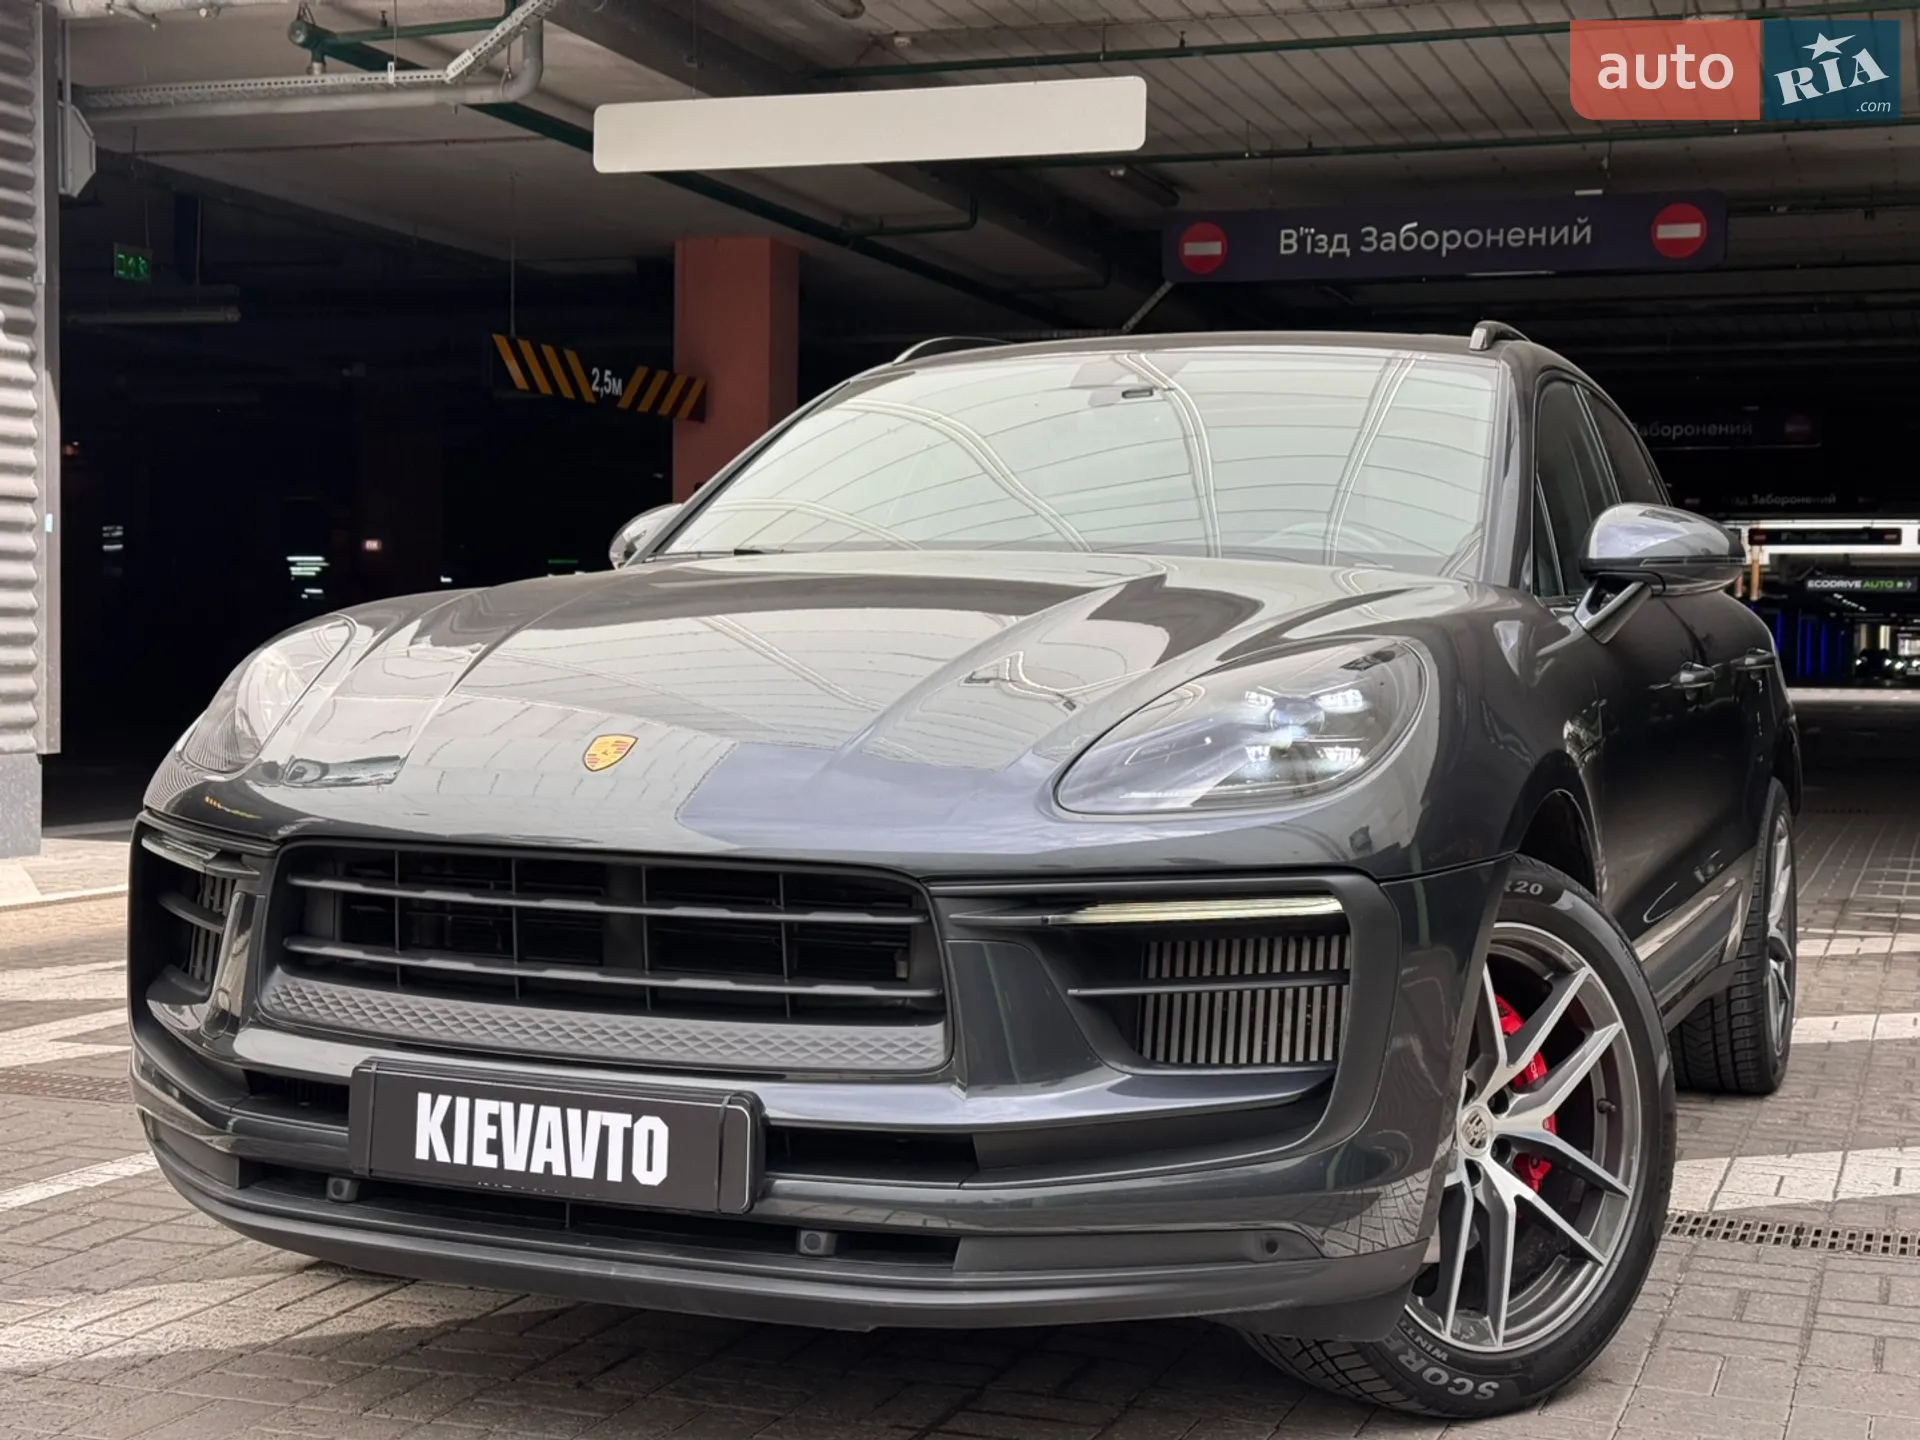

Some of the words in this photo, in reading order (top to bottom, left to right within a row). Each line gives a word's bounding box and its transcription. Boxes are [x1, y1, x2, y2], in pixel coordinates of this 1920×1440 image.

[1279, 226, 1351, 257] В'їзд
[1360, 217, 1593, 257] Заборонений
[1807, 579, 1862, 589] ECODRIVE
[1863, 579, 1894, 589] AUTO
[415, 1091, 669, 1187] KIEVAVTO
